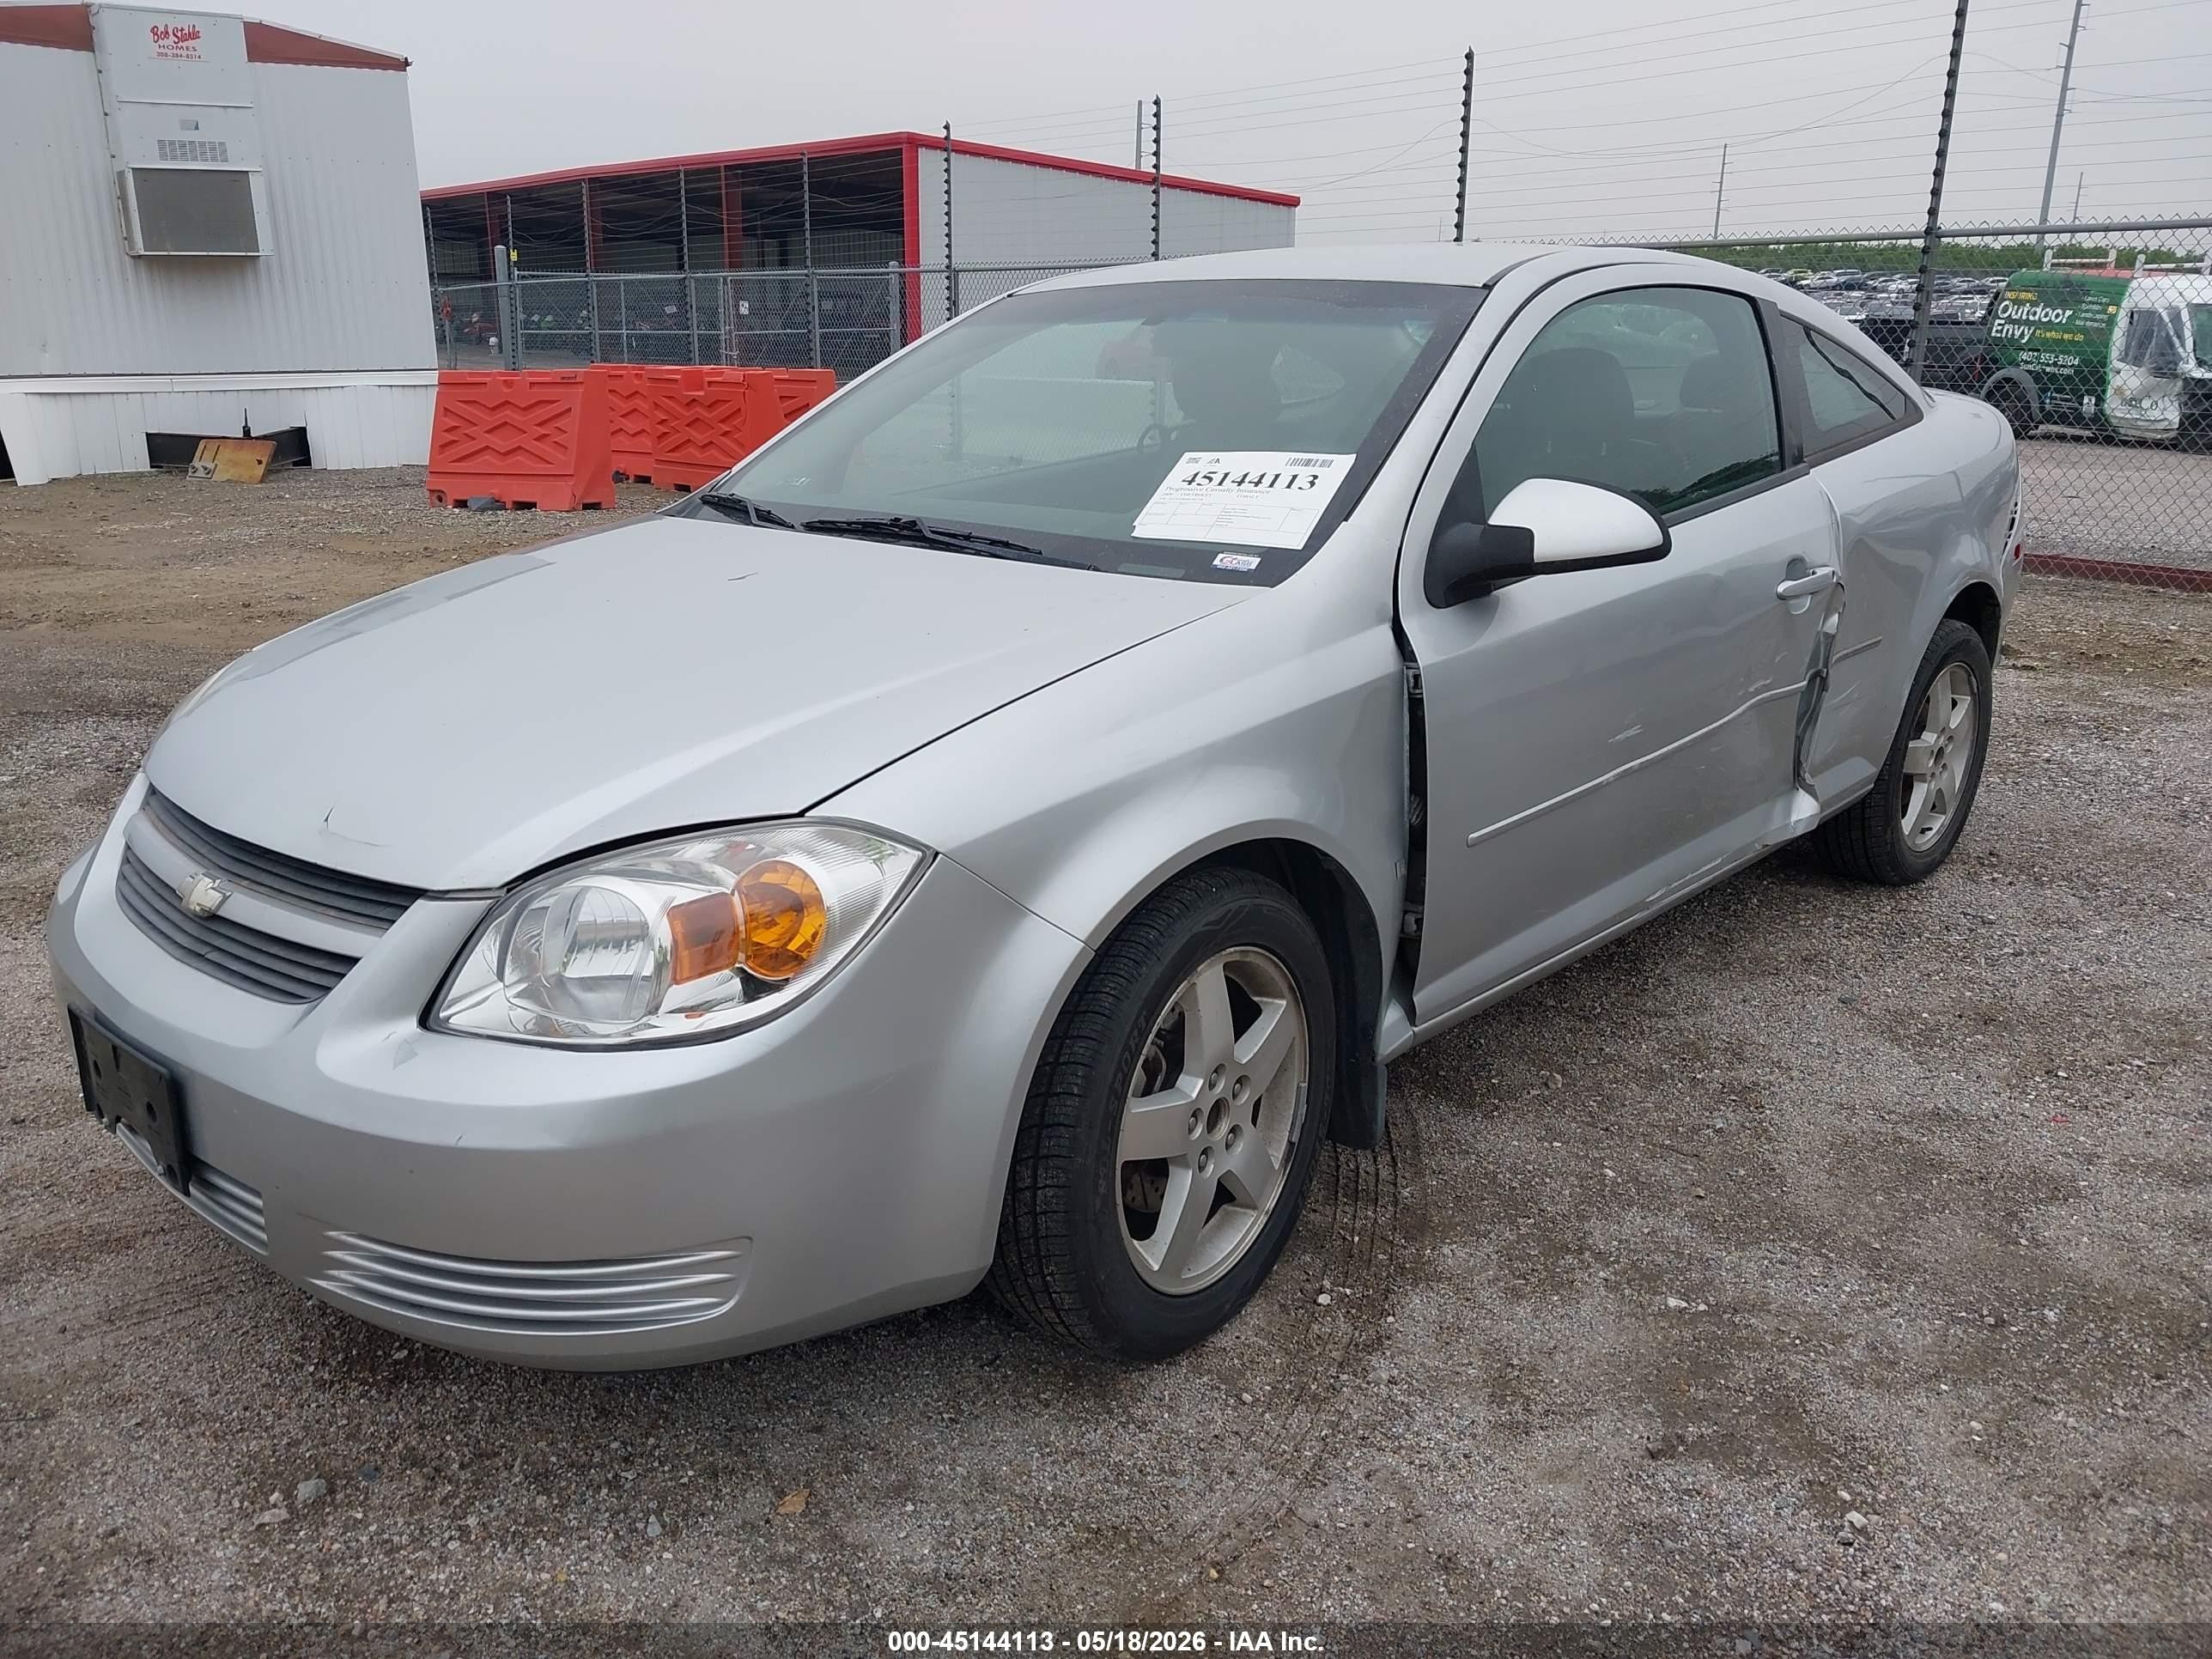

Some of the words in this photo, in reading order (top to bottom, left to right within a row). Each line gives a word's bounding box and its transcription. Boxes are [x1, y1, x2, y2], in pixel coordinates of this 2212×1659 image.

[150, 23, 170, 44] Bob
[1997, 300, 2074, 324] Outdoor
[1990, 319, 2035, 343] Envy
[1181, 471, 1319, 490] 45144113
